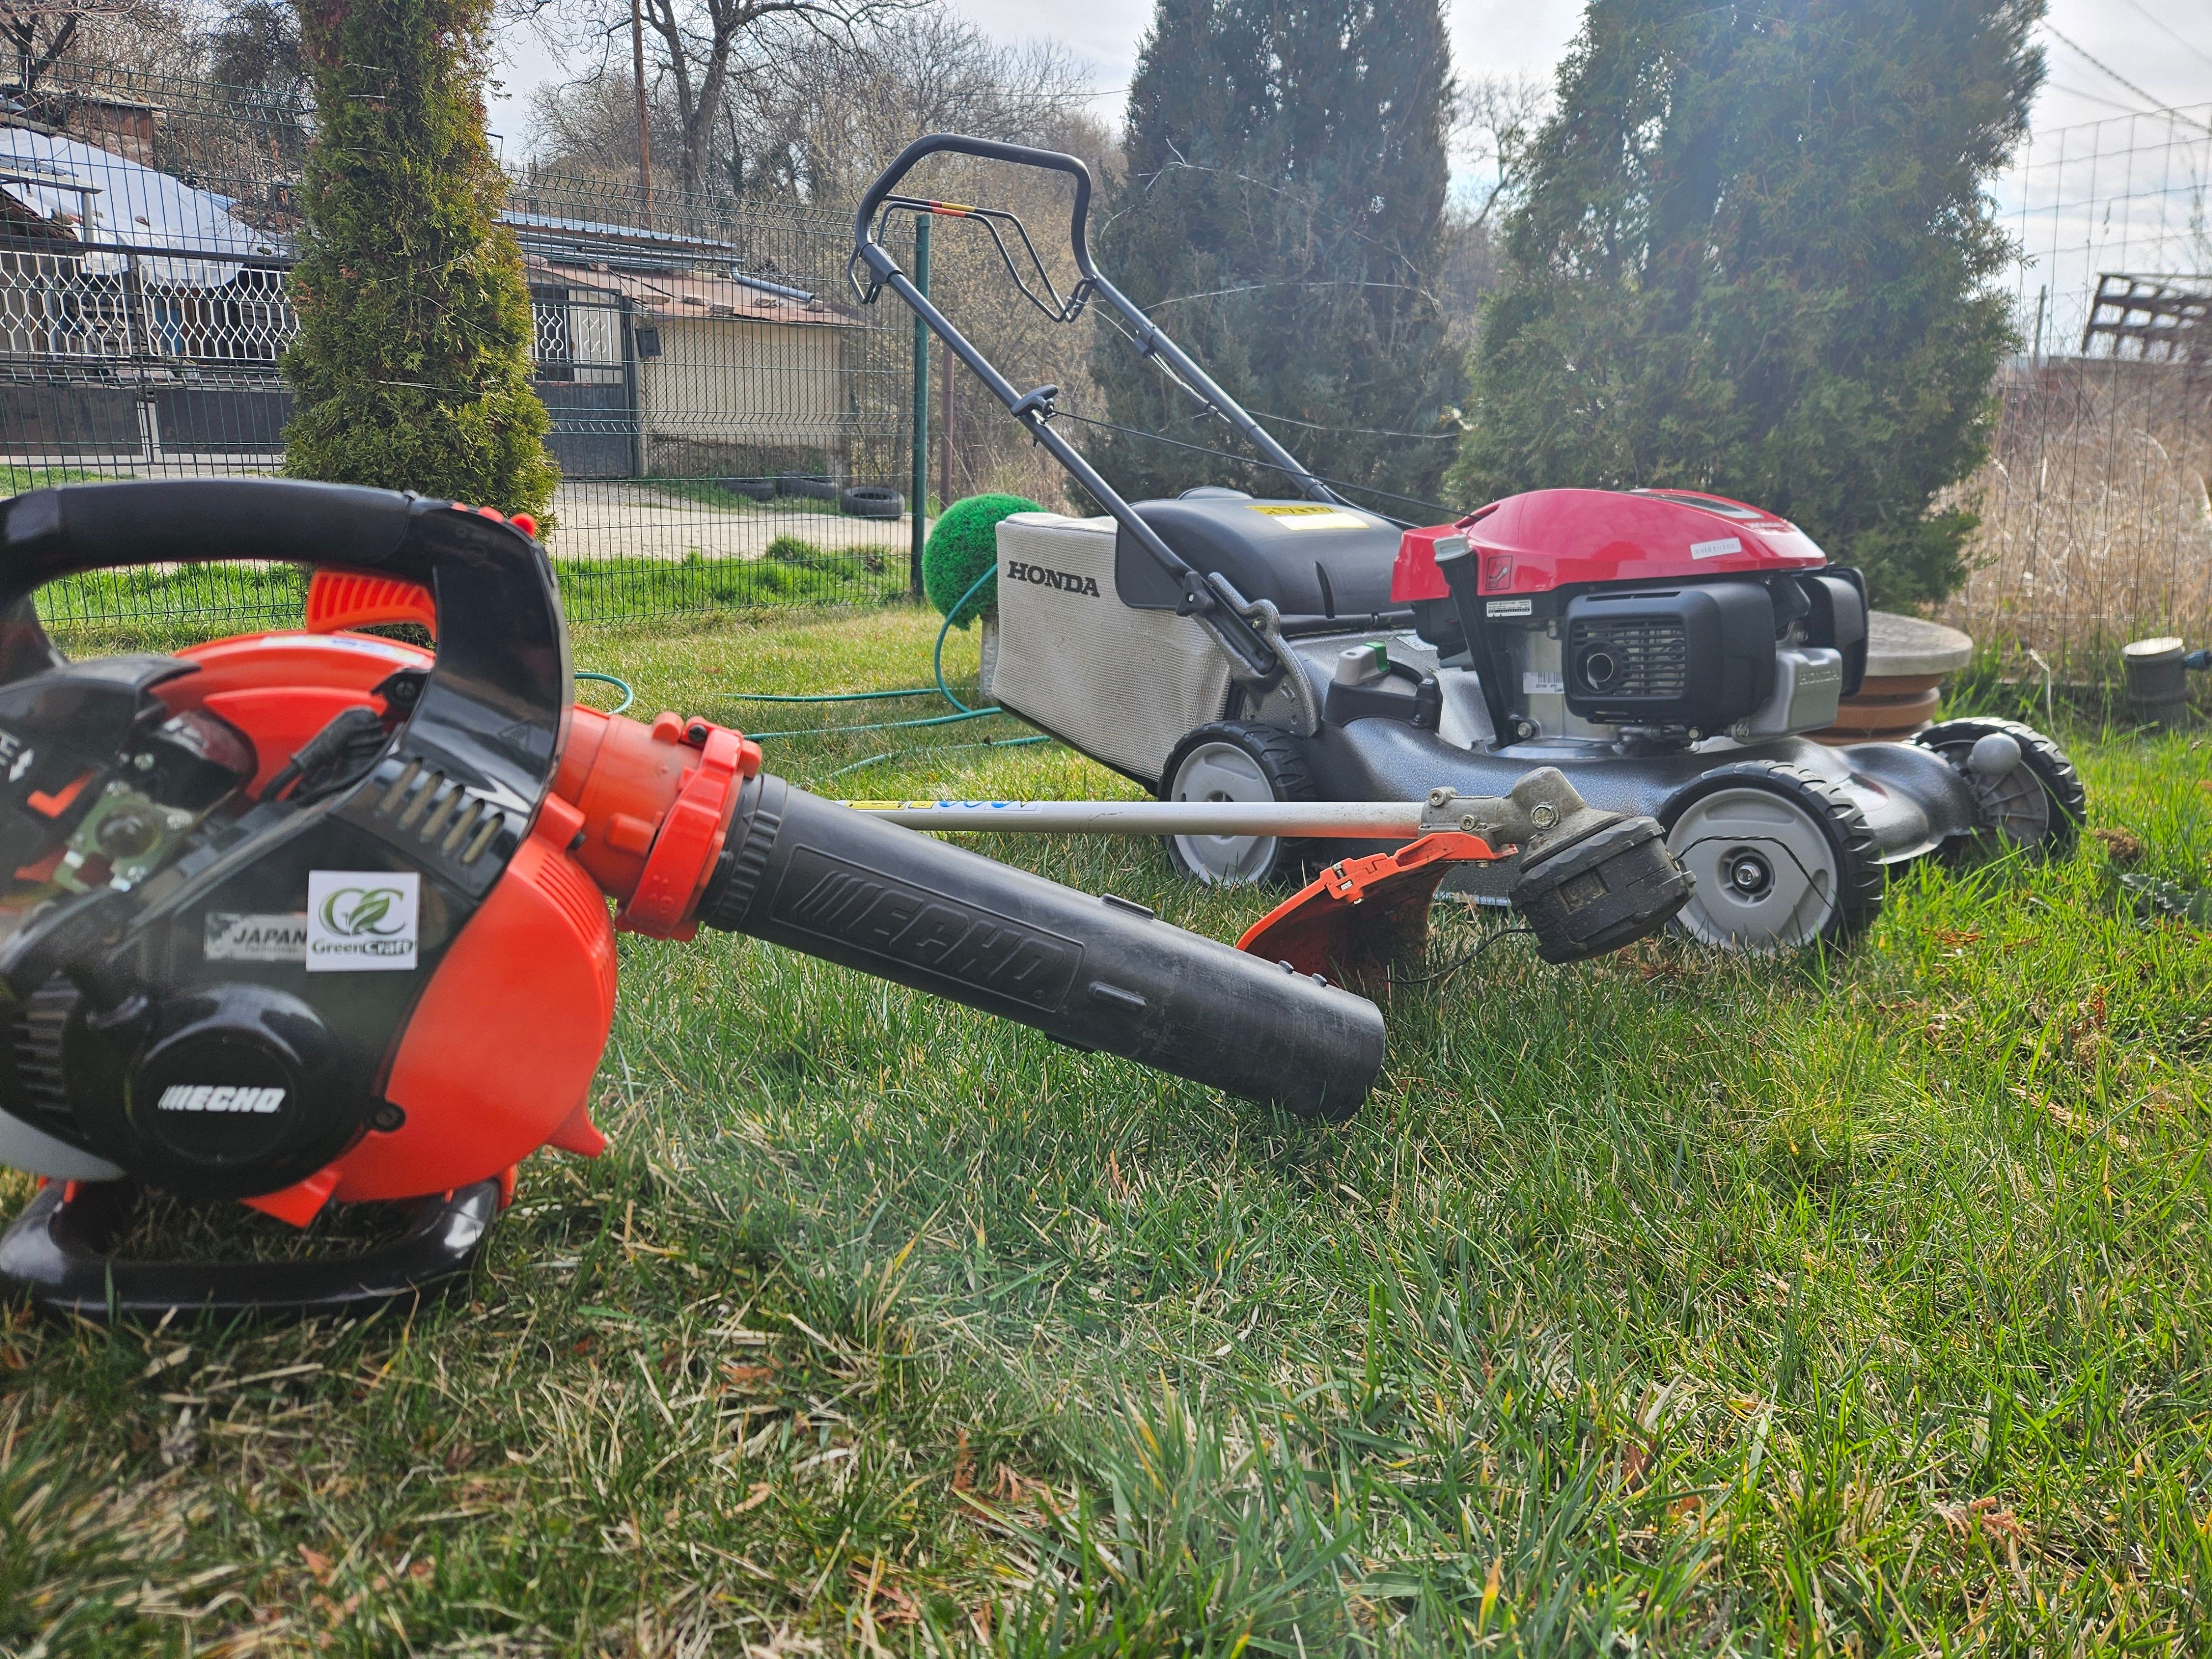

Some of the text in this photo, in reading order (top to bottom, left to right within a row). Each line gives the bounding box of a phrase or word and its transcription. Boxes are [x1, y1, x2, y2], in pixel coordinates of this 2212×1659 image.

[1007, 560, 1100, 598] HONDA
[232, 926, 307, 945] JAPAN
[311, 940, 413, 956] GreenCraft
[842, 888, 1065, 990] ECHO
[184, 1085, 286, 1113] ECHO
